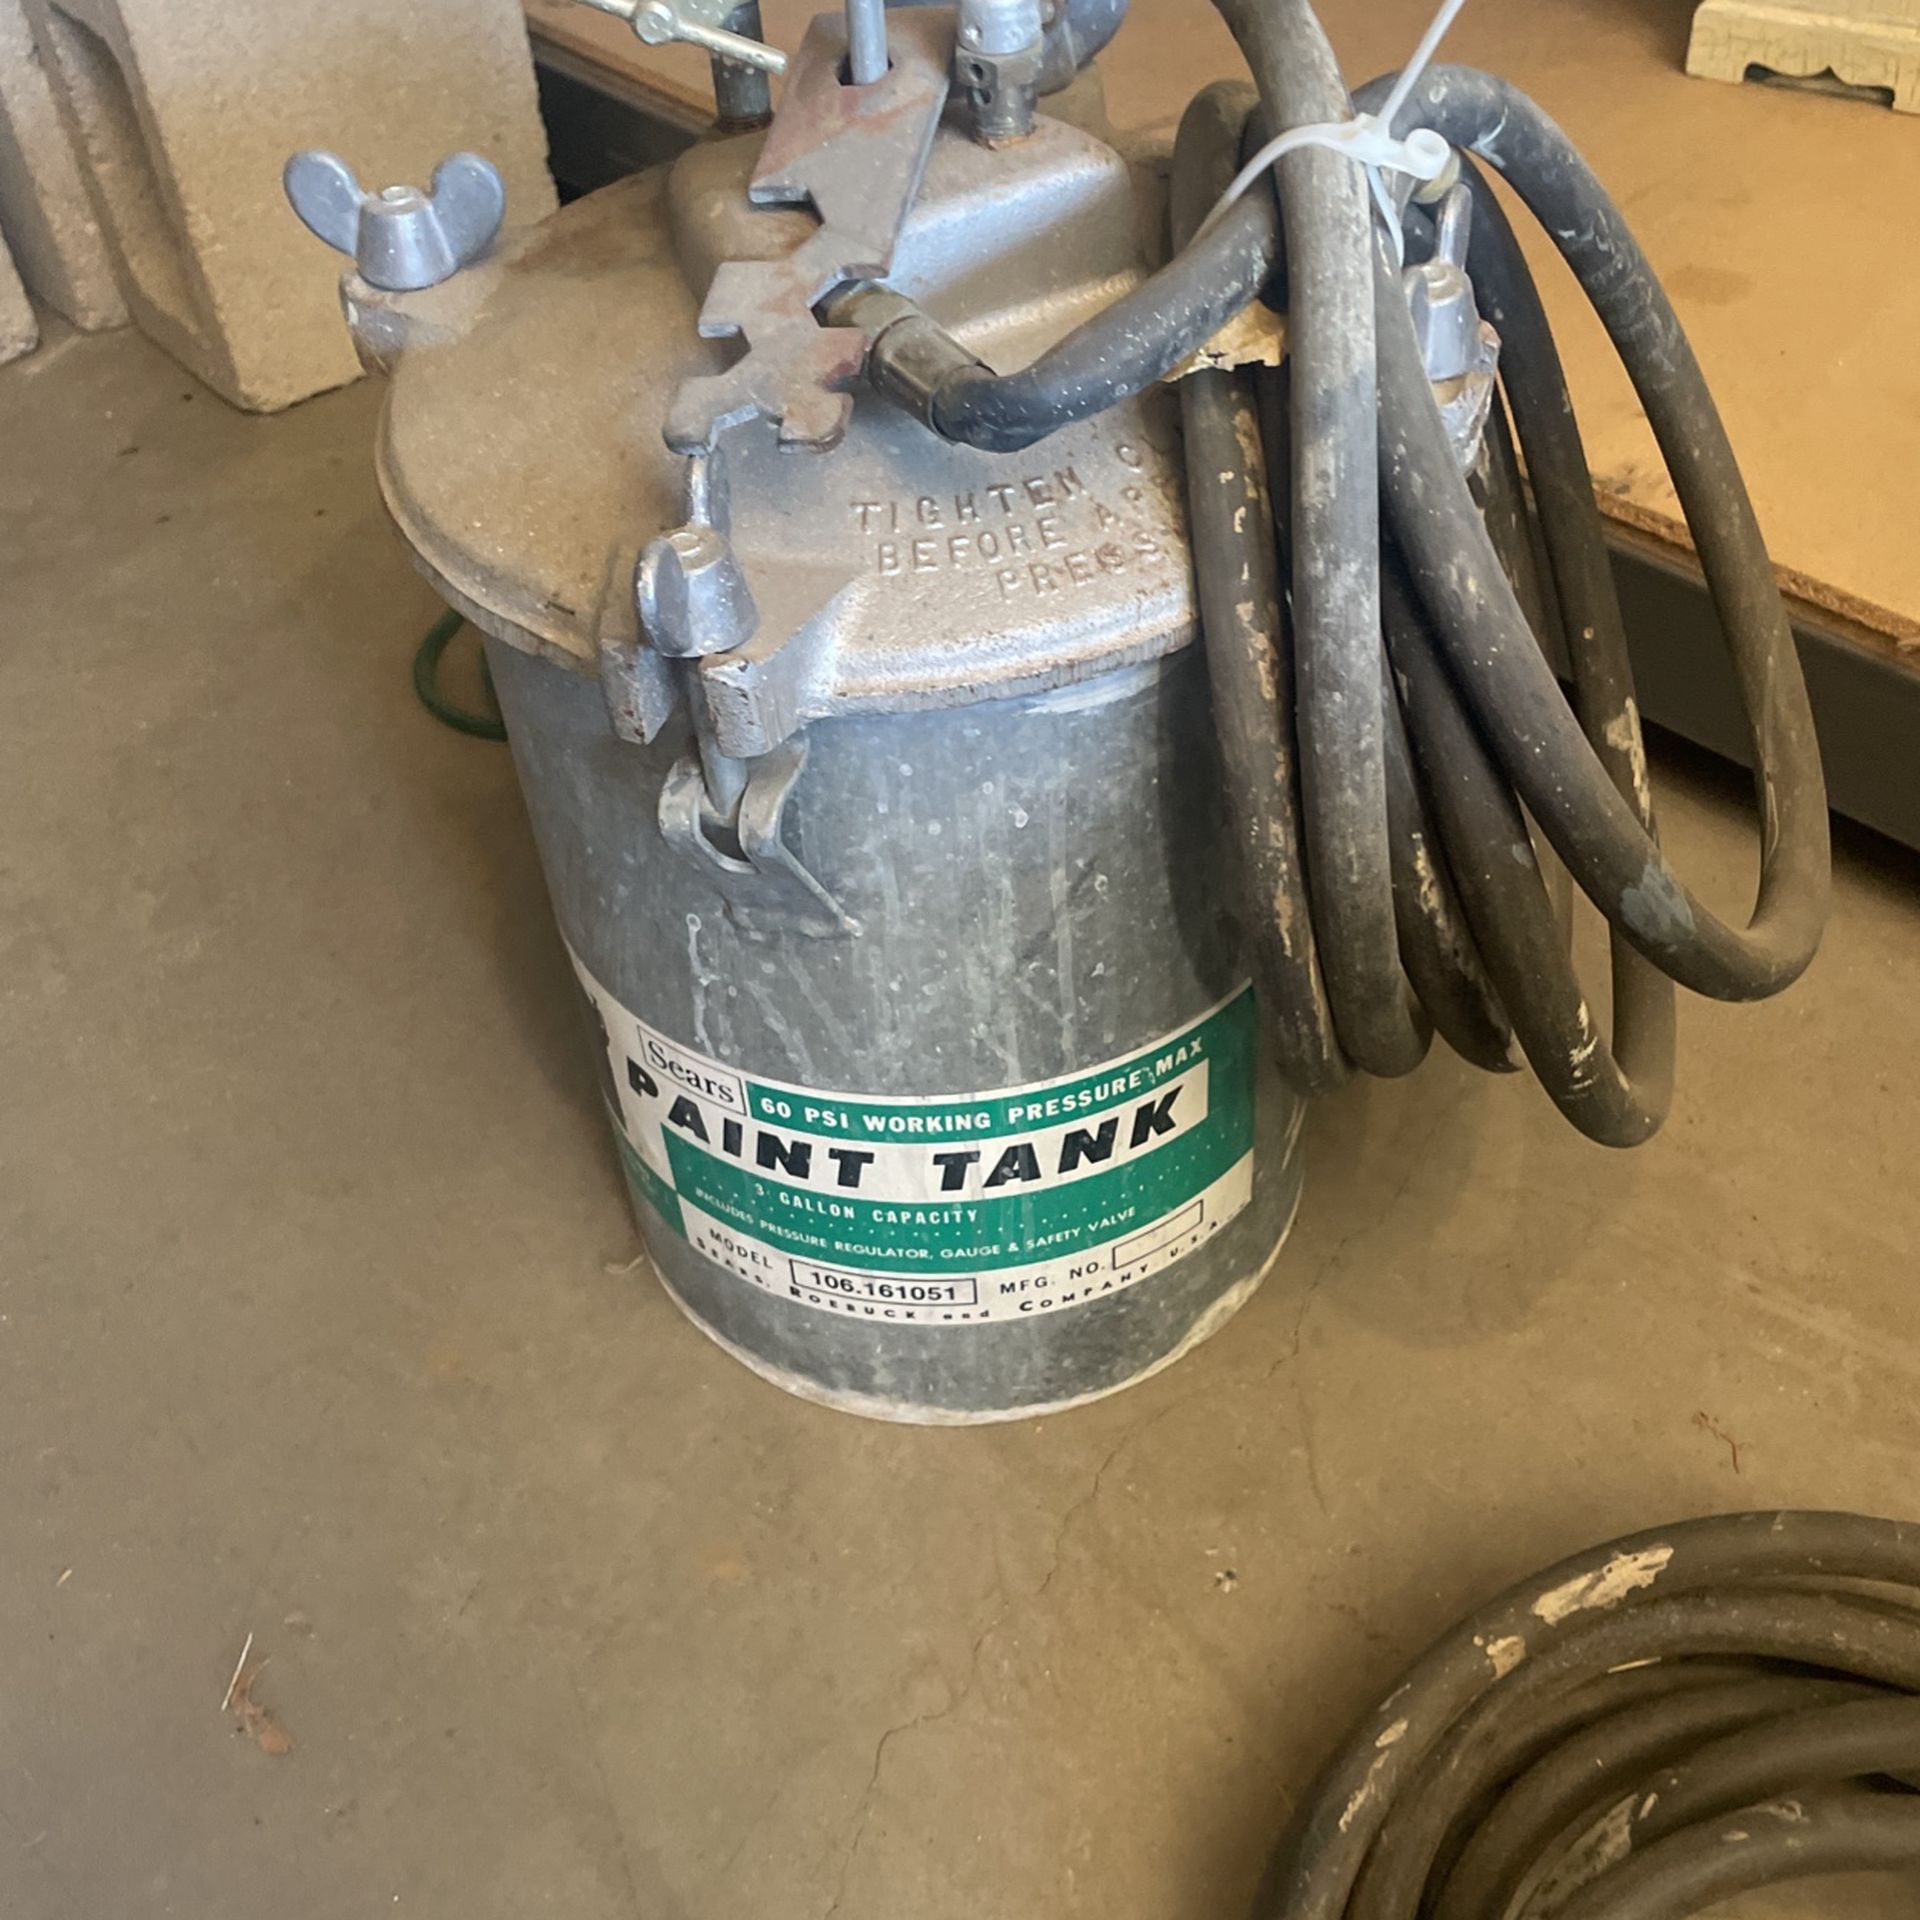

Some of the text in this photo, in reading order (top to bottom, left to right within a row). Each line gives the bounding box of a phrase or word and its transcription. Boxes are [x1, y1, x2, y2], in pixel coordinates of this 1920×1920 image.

[850, 466, 1088, 534] TIGHTEN
[878, 517, 1067, 577] BEFORE
[647, 1039, 735, 1104] Sears
[760, 1036, 1204, 1134] 60 PSI WORKING PRESSURE MAX
[627, 1056, 1184, 1192] PAINT TANK
[760, 1220, 828, 1249] PRESSURE
[940, 1244, 1000, 1259] GAUGE
[1007, 1240, 1021, 1253] &
[1026, 1228, 1082, 1250] SAFETY
[1088, 1206, 1136, 1233] VALVE
[779, 1191, 856, 1220] GALLON
[872, 1208, 978, 1225] CAPACITY
[709, 1227, 774, 1269] MODEL
[810, 1271, 957, 1301] 106.161051
[1018, 1264, 1149, 1312] COMPANY
